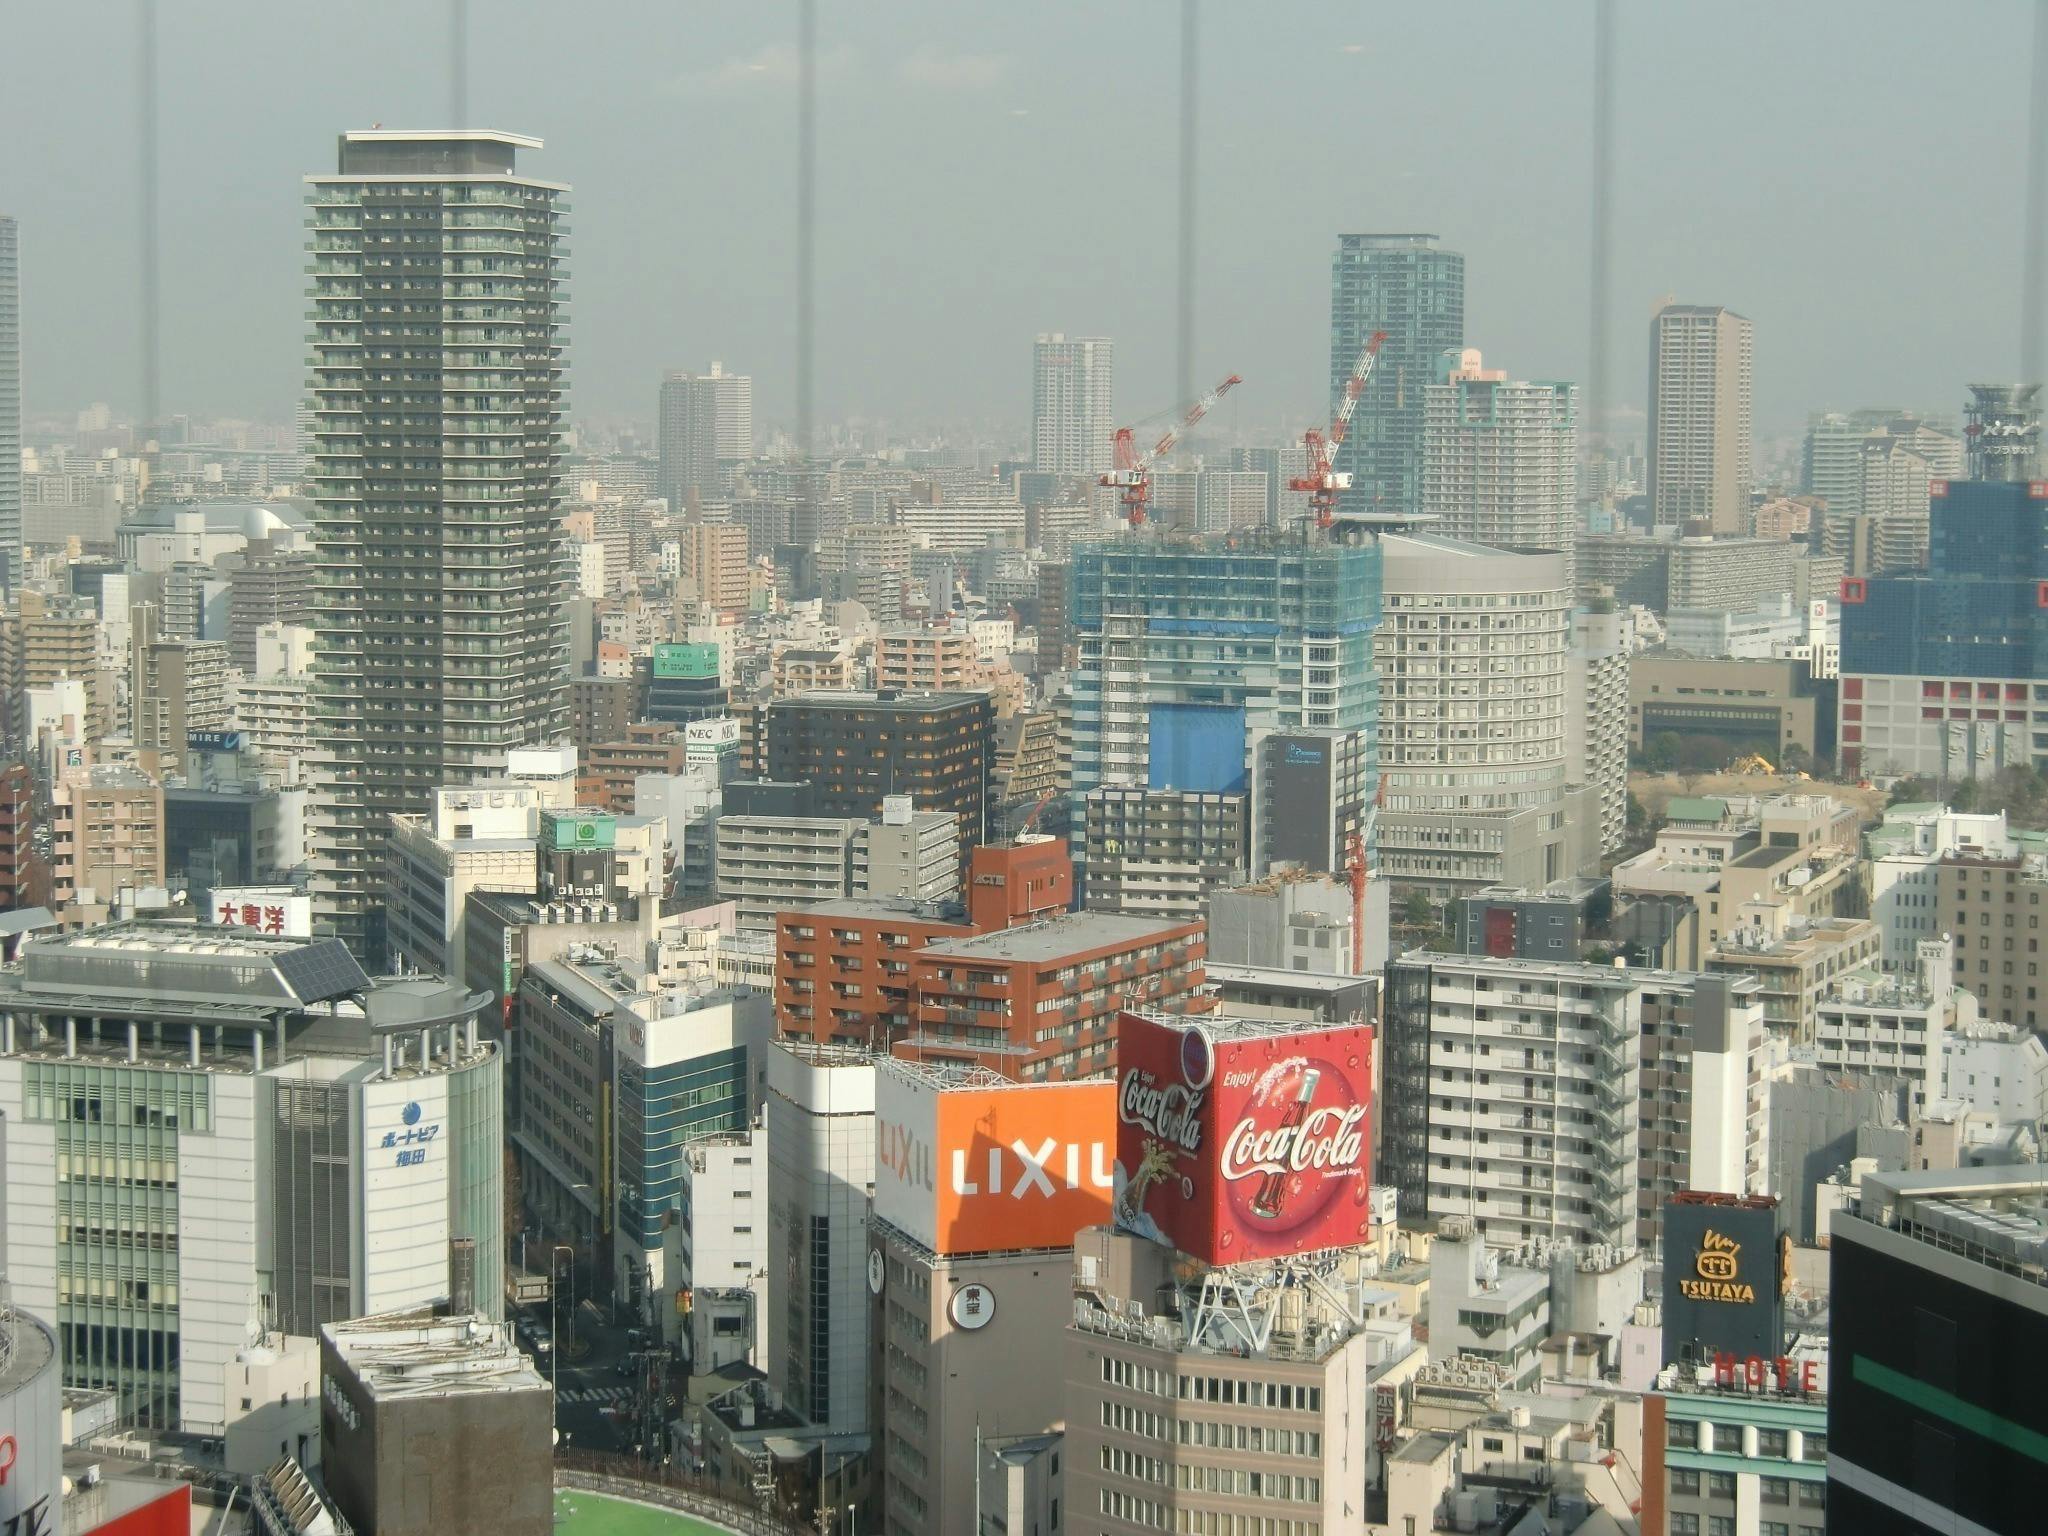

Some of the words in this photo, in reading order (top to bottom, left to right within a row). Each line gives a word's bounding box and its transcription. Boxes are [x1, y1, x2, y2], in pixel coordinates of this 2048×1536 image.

[689, 729, 712, 739] NEC
[1222, 1068, 1258, 1088] Enjoy!
[1119, 1067, 1203, 1150] Coca-Cola
[396, 1148, 426, 1168] 梅田
[879, 1119, 933, 1193] LIXIL
[952, 1136, 1113, 1200] LIXIL
[1220, 1103, 1369, 1181] Coca-Cola
[1680, 1280, 1755, 1300] TSUTAYA
[1377, 1390, 1394, 1442] ホテル
